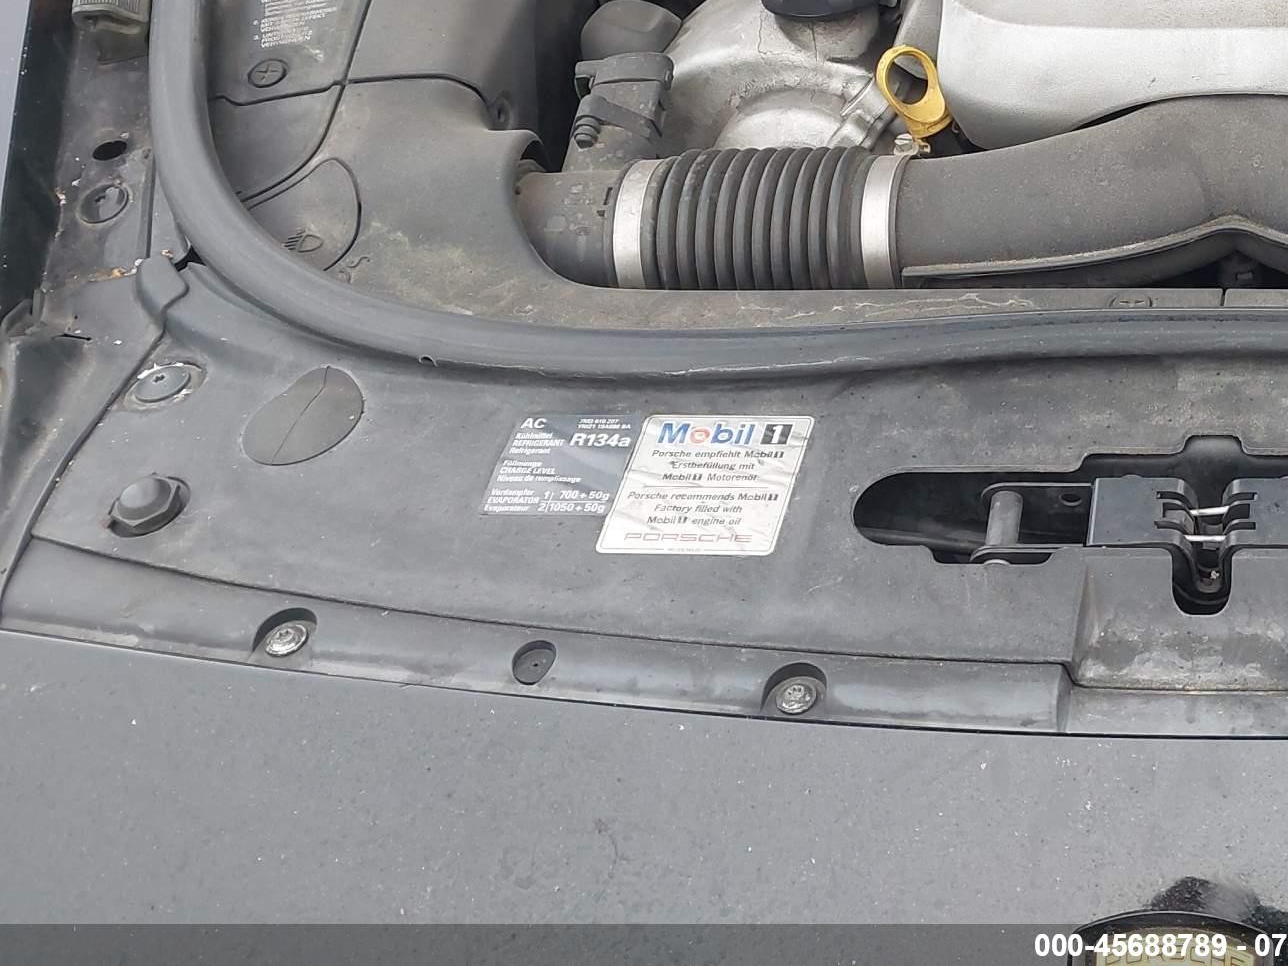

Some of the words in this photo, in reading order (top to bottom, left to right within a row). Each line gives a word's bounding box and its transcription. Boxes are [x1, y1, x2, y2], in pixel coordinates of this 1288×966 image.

[520, 418, 548, 429] AC
[657, 422, 756, 445] Mobil
[570, 433, 631, 447] R134a
[652, 450, 692, 458] Porsche
[694, 450, 741, 459] empfiehlt
[672, 461, 735, 470] Erstbefüllung
[741, 462, 755, 470] mit
[500, 467, 532, 475] CHARGE
[533, 467, 556, 475] LEVEL
[560, 491, 580, 499] 700
[627, 491, 668, 499] Porsche
[670, 492, 734, 500] recommends
[654, 505, 692, 513] Factory
[694, 505, 720, 513] filled
[722, 505, 742, 513] with
[647, 516, 676, 524] Mobil
[691, 518, 725, 526] engine
[728, 517, 741, 525] oil
[624, 533, 753, 543] PORSCHE
